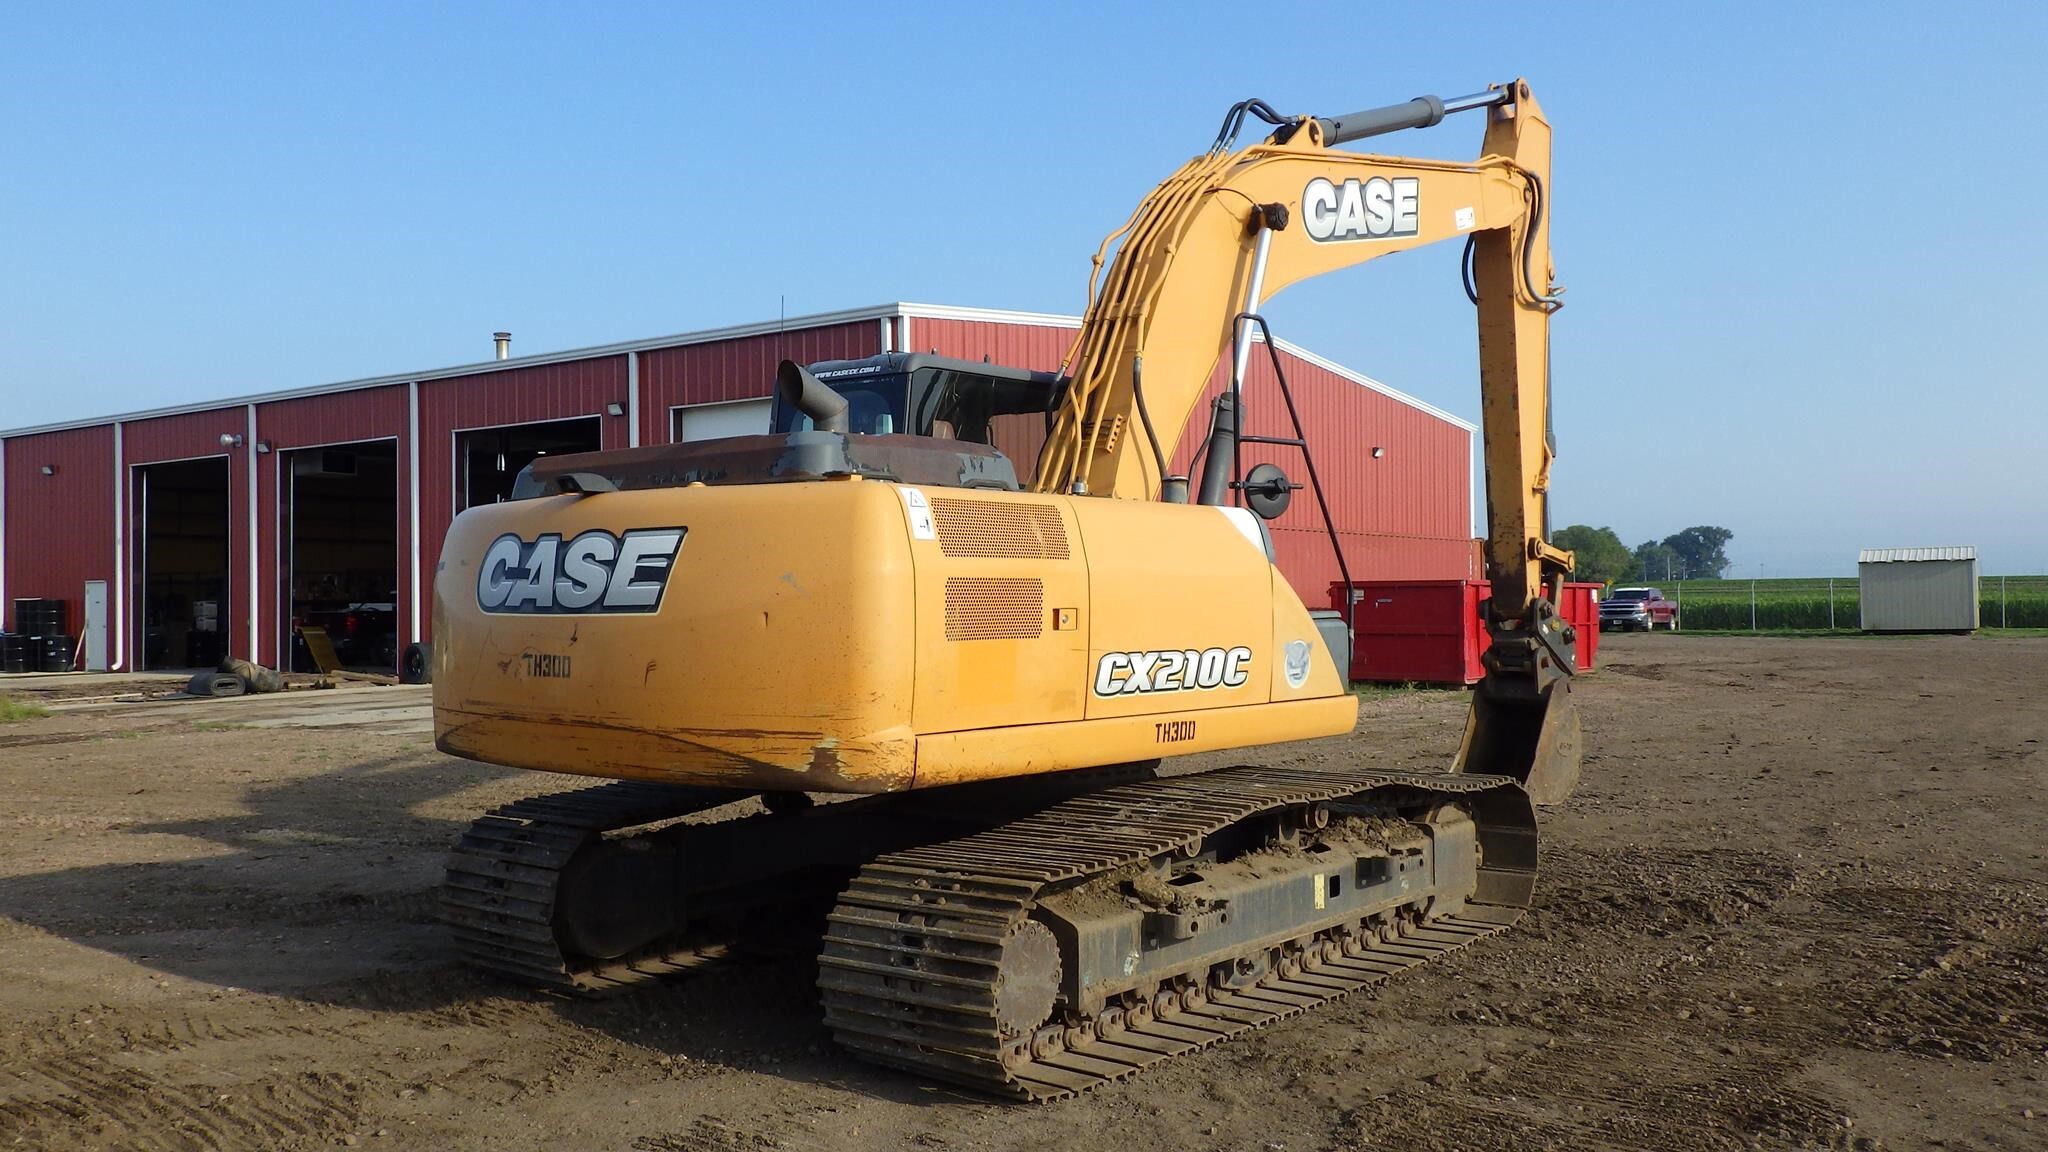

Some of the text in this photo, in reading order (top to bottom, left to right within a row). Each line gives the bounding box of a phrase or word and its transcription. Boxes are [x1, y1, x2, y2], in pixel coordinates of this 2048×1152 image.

[1303, 177, 1419, 241] CASE
[479, 529, 684, 611] CASE
[522, 653, 571, 678] TH300
[1095, 647, 1252, 695] CX210C
[1155, 720, 1196, 743] TH300
